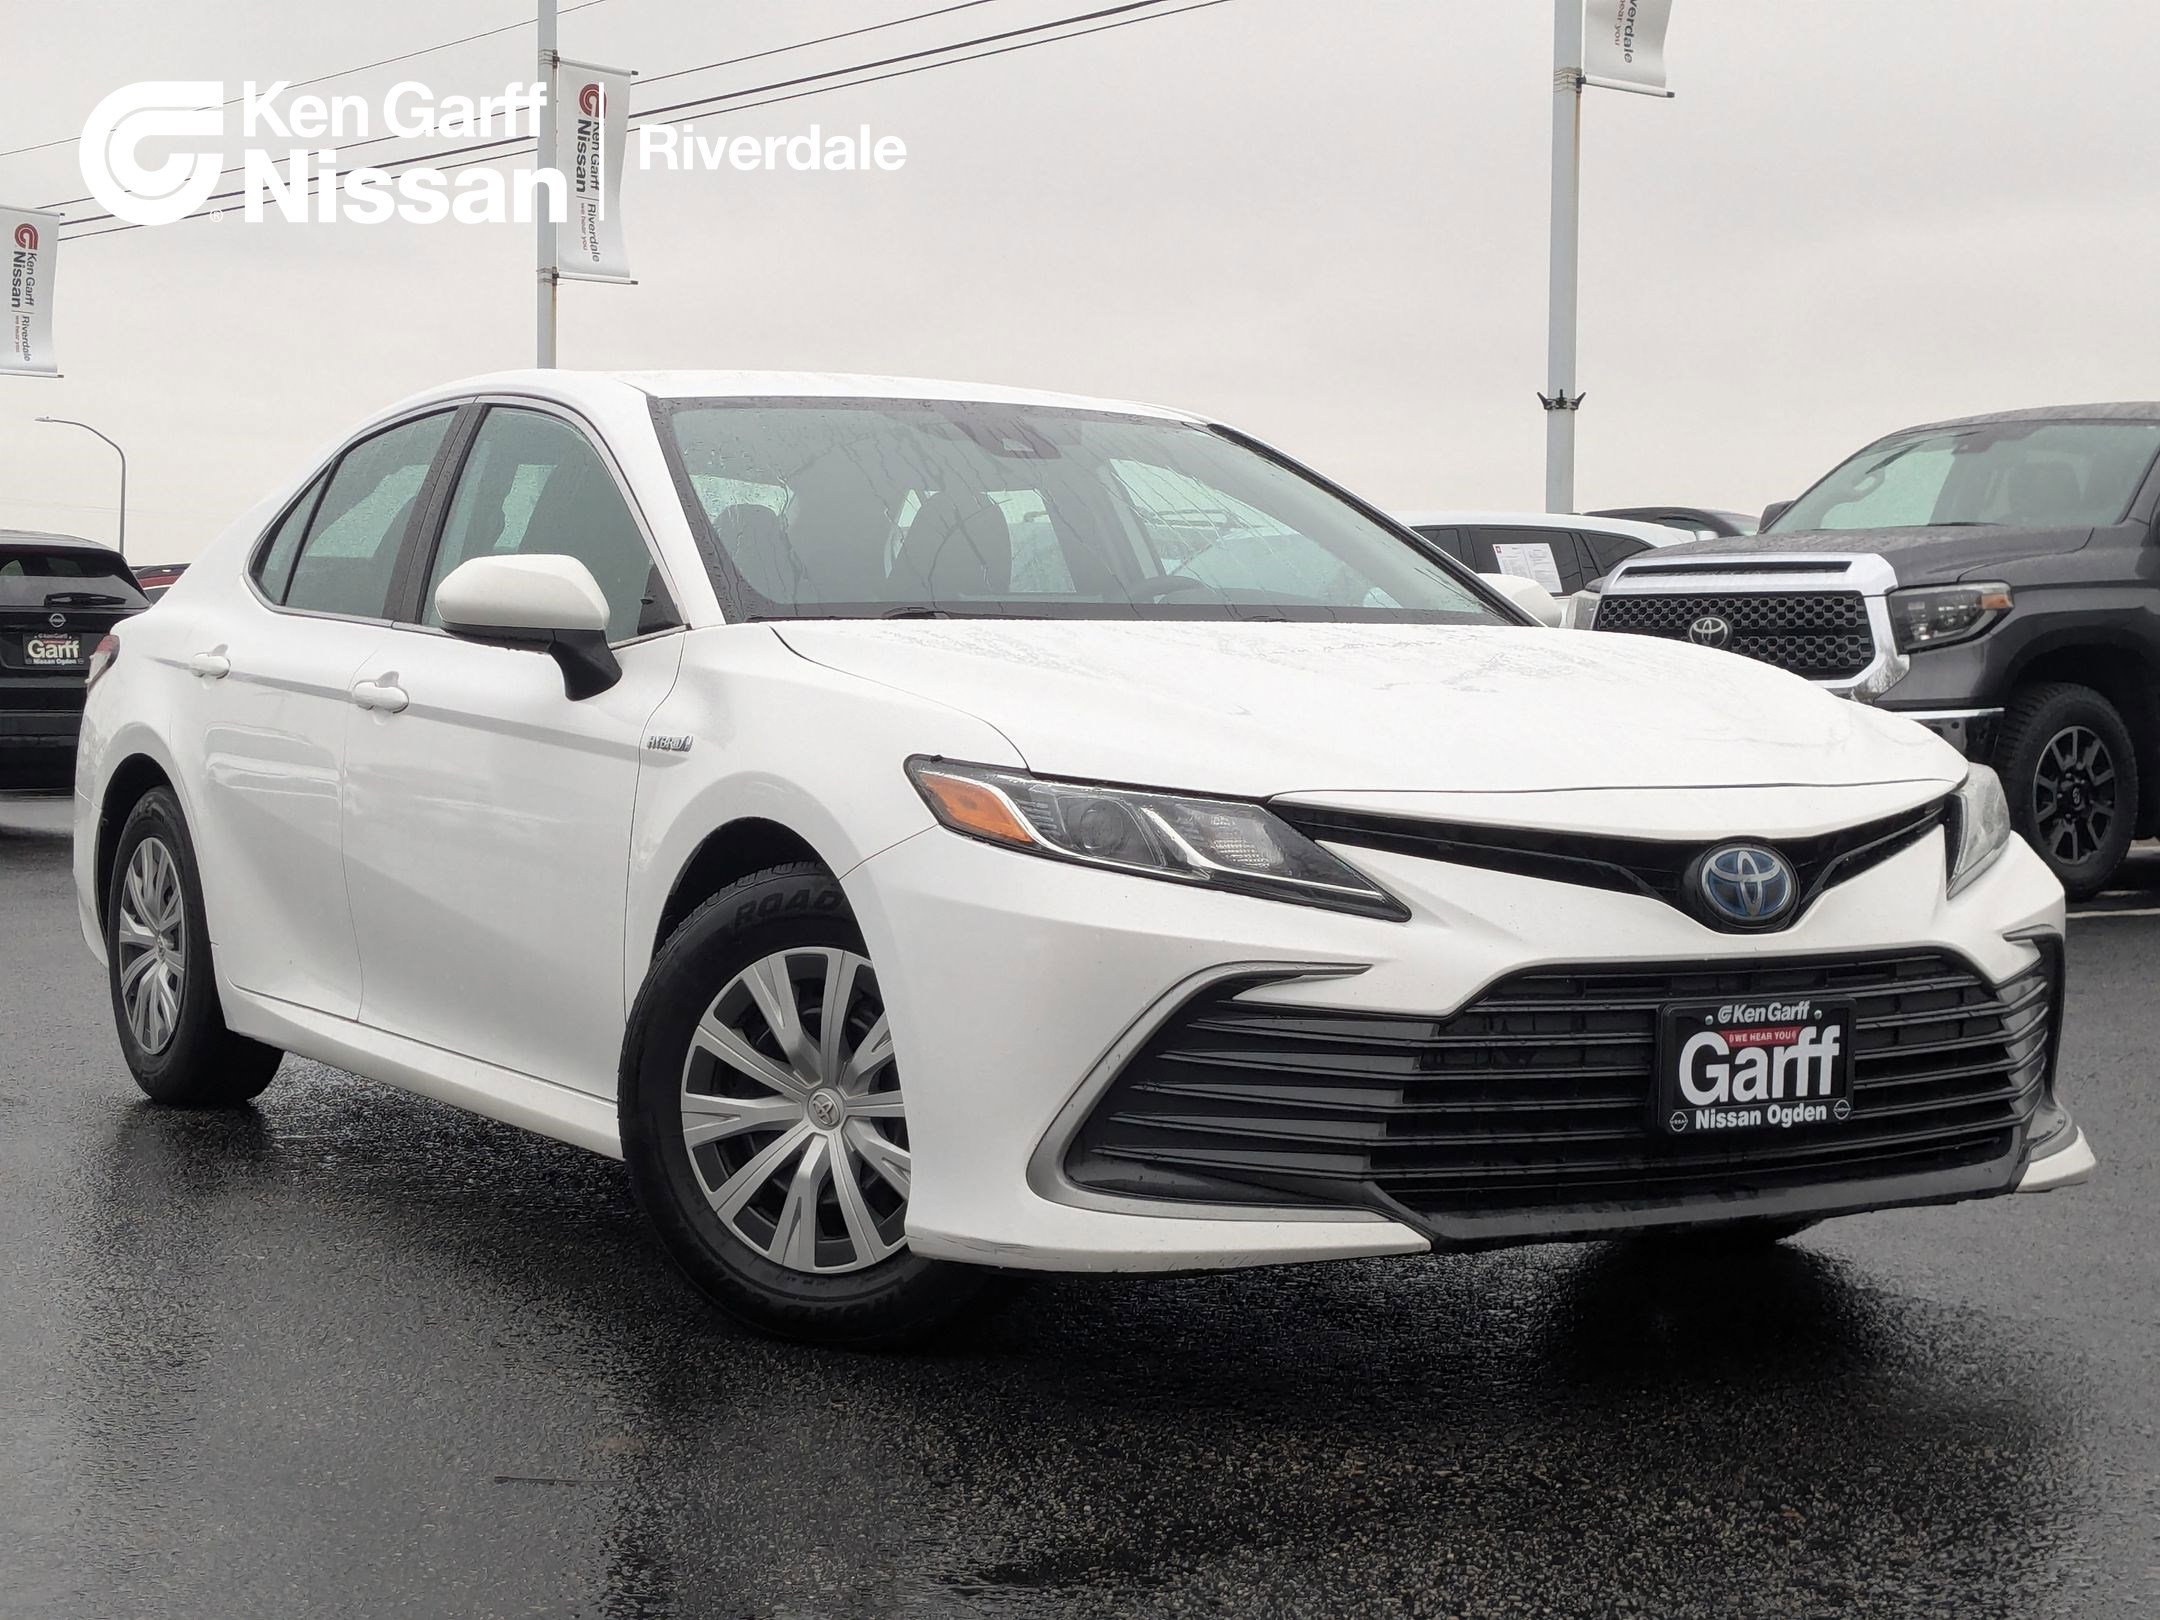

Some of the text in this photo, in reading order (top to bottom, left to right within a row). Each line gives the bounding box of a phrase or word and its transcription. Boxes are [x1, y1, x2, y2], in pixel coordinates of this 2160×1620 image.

[577, 119, 591, 192] Nissan
[587, 203, 600, 262] Riverdale
[11, 250, 26, 308] Nissan
[25, 252, 37, 307] Ken Garff
[27, 639, 80, 658] Garff
[1732, 1000, 1811, 1024] Ken Garff
[1734, 1030, 1791, 1043] WE HEAR YOU
[1678, 1024, 1841, 1106] Garff
[1695, 1102, 1827, 1130] Nissan Ogden
